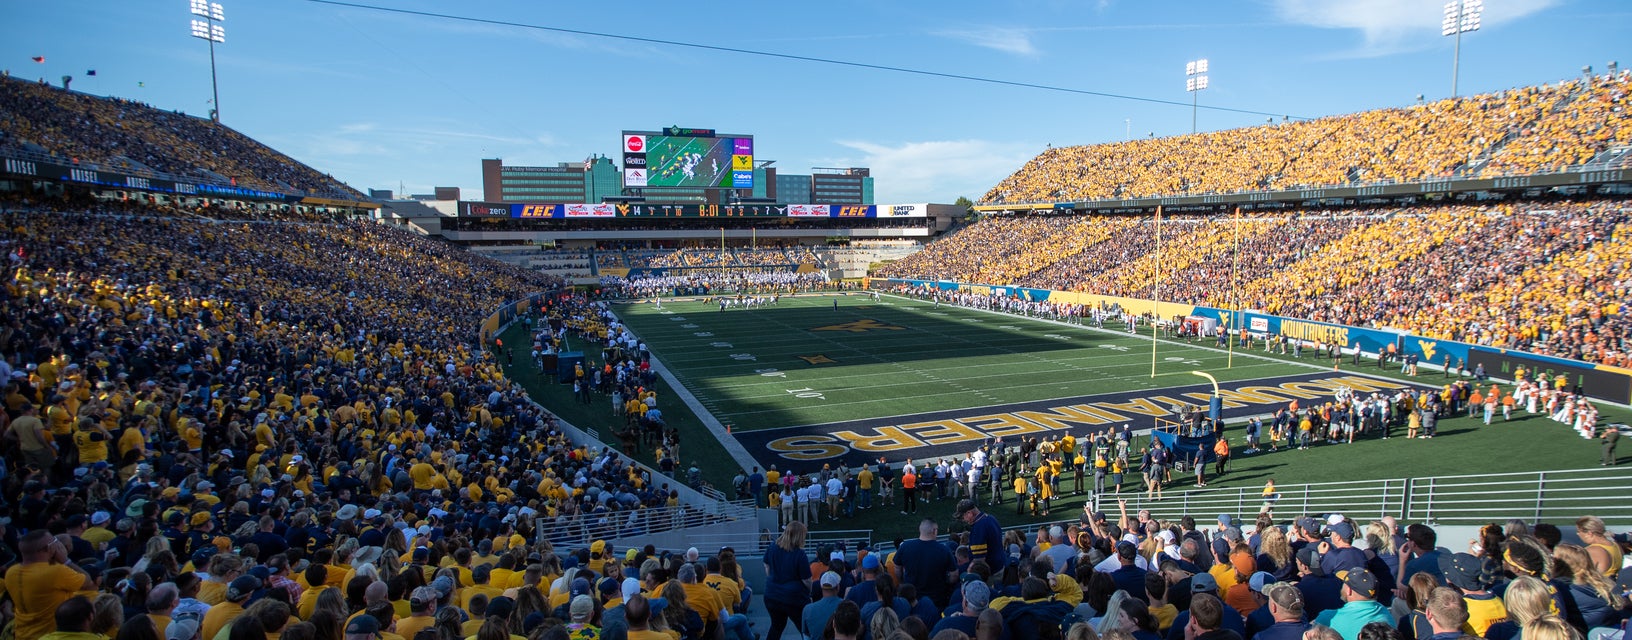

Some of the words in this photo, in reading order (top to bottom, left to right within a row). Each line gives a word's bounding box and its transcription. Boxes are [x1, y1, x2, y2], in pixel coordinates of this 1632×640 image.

[1420, 182, 1452, 192] NOISE!
[522, 205, 555, 217] CEC
[634, 206, 640, 215] 14
[700, 205, 719, 216] 8:01
[839, 206, 868, 216] CEC
[1280, 319, 1348, 347] MOUNTAINEERS
